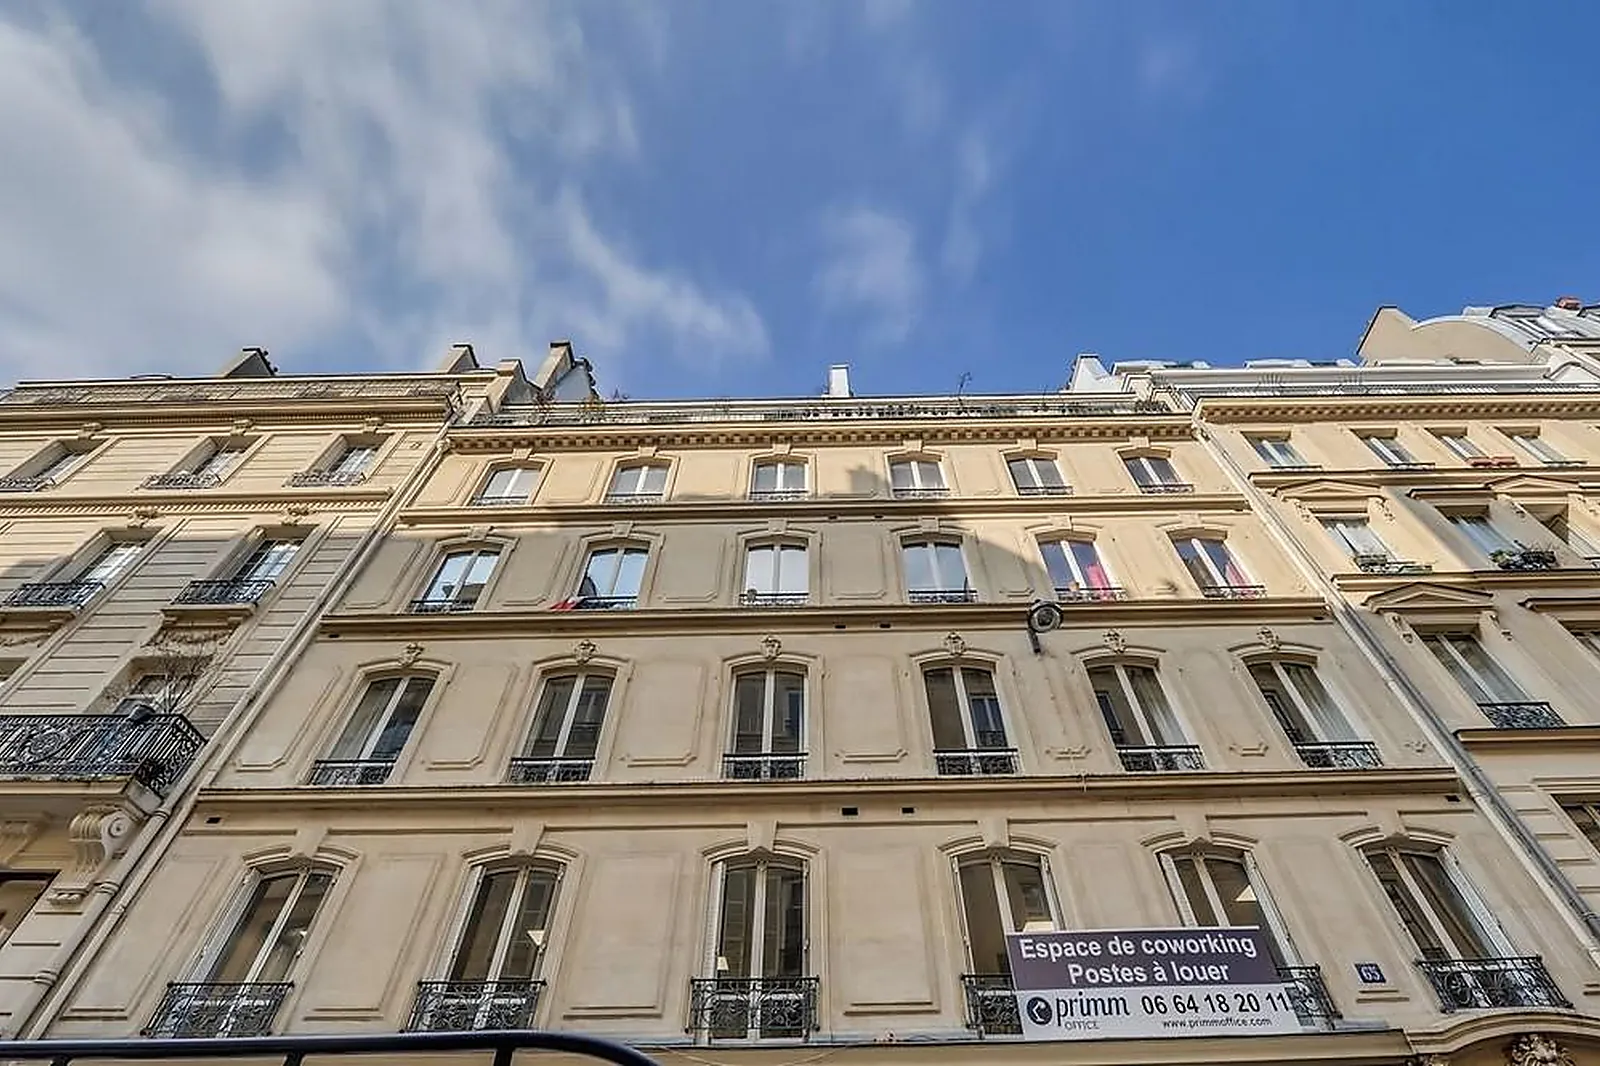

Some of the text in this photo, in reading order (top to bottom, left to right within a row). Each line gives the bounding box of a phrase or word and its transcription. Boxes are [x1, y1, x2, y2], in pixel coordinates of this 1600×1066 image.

[1019, 933, 1257, 962] Espace de coworking
[1068, 961, 1229, 984] Postes à louer
[1056, 991, 1130, 1026] primm
[1141, 992, 1289, 1015] 06 64 18 20 11
[1163, 1017, 1272, 1029] www.primmoffice.com
